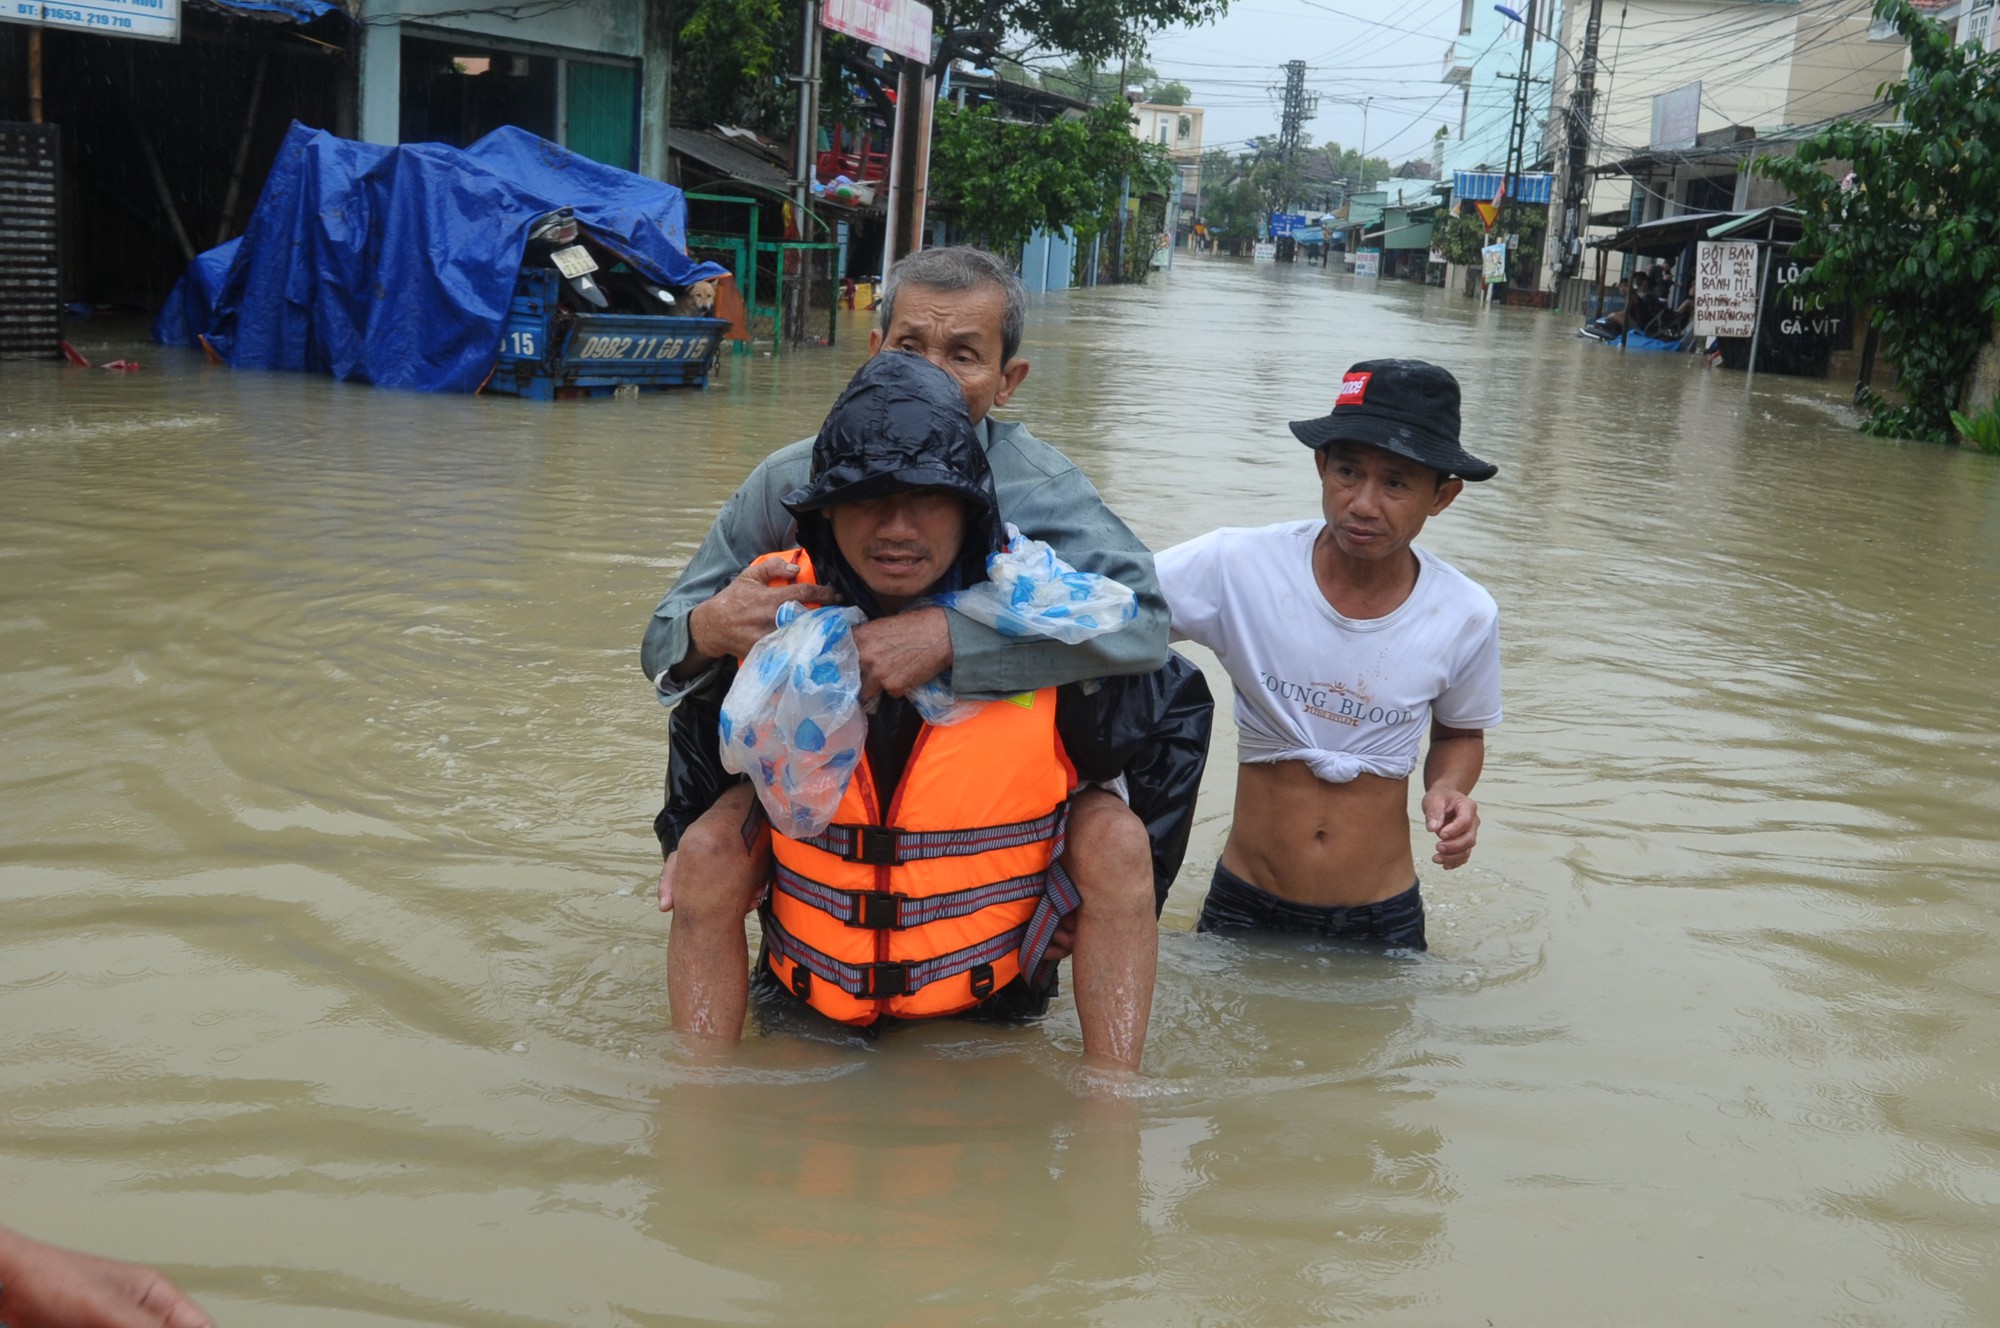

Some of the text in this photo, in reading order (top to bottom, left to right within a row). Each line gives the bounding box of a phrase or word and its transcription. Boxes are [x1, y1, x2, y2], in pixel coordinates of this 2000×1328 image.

[87, 12, 109, 25] 219
[112, 16, 132, 28] 710
[1702, 274, 1730, 290] BÁNH
[511, 332, 534, 355] 15
[580, 336, 633, 360] 0982
[632, 337, 655, 360] 11
[684, 337, 708, 360] 15
[1338, 698, 1413, 726] BLOOD
